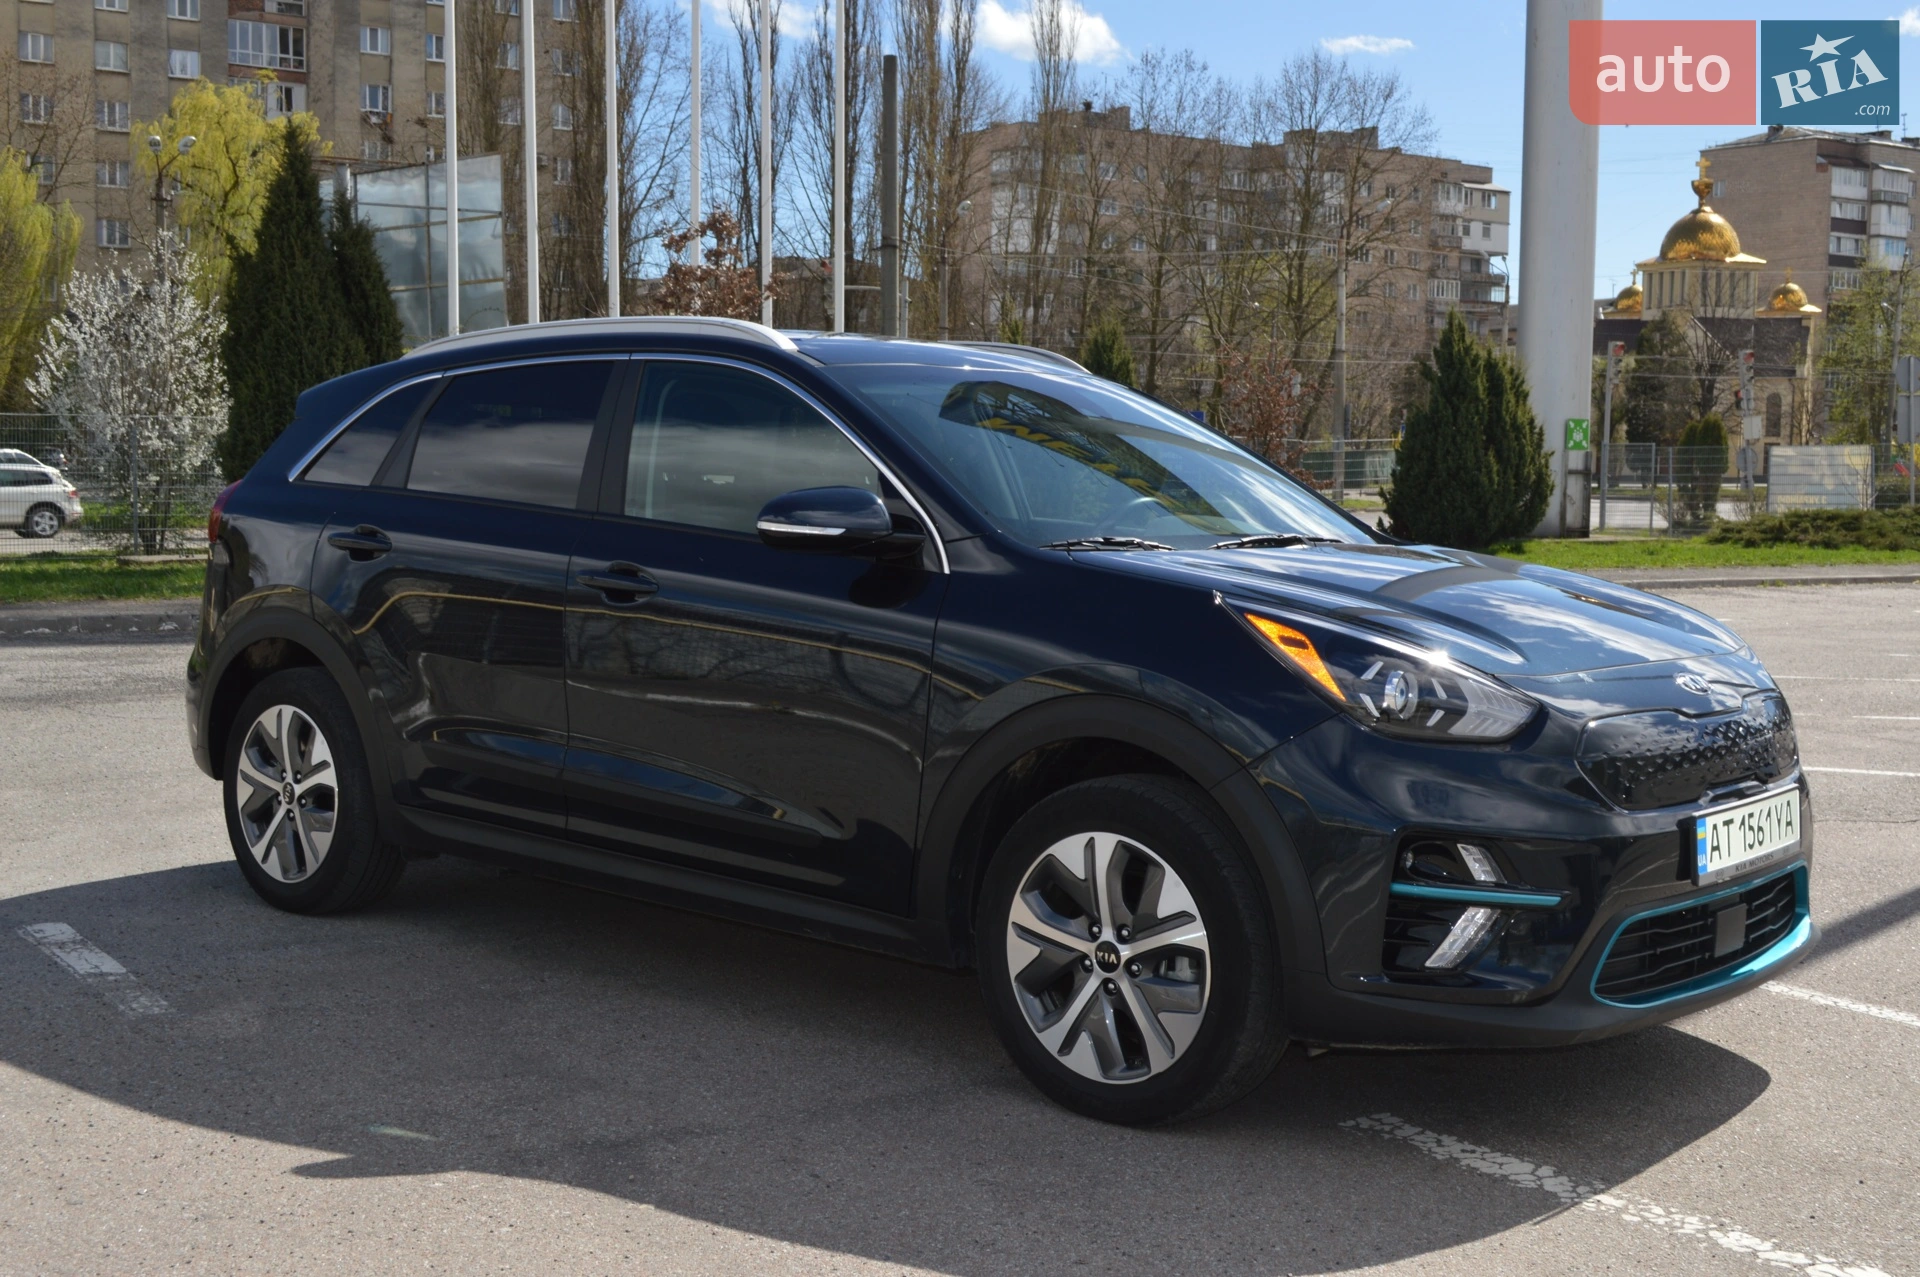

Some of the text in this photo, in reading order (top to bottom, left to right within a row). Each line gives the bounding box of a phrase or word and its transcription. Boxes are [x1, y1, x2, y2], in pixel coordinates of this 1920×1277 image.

[1710, 818, 1734, 863] AT
[1697, 854, 1707, 867] UA
[1735, 854, 1774, 873] KIA MOTORS
[1096, 951, 1117, 964] KIA
